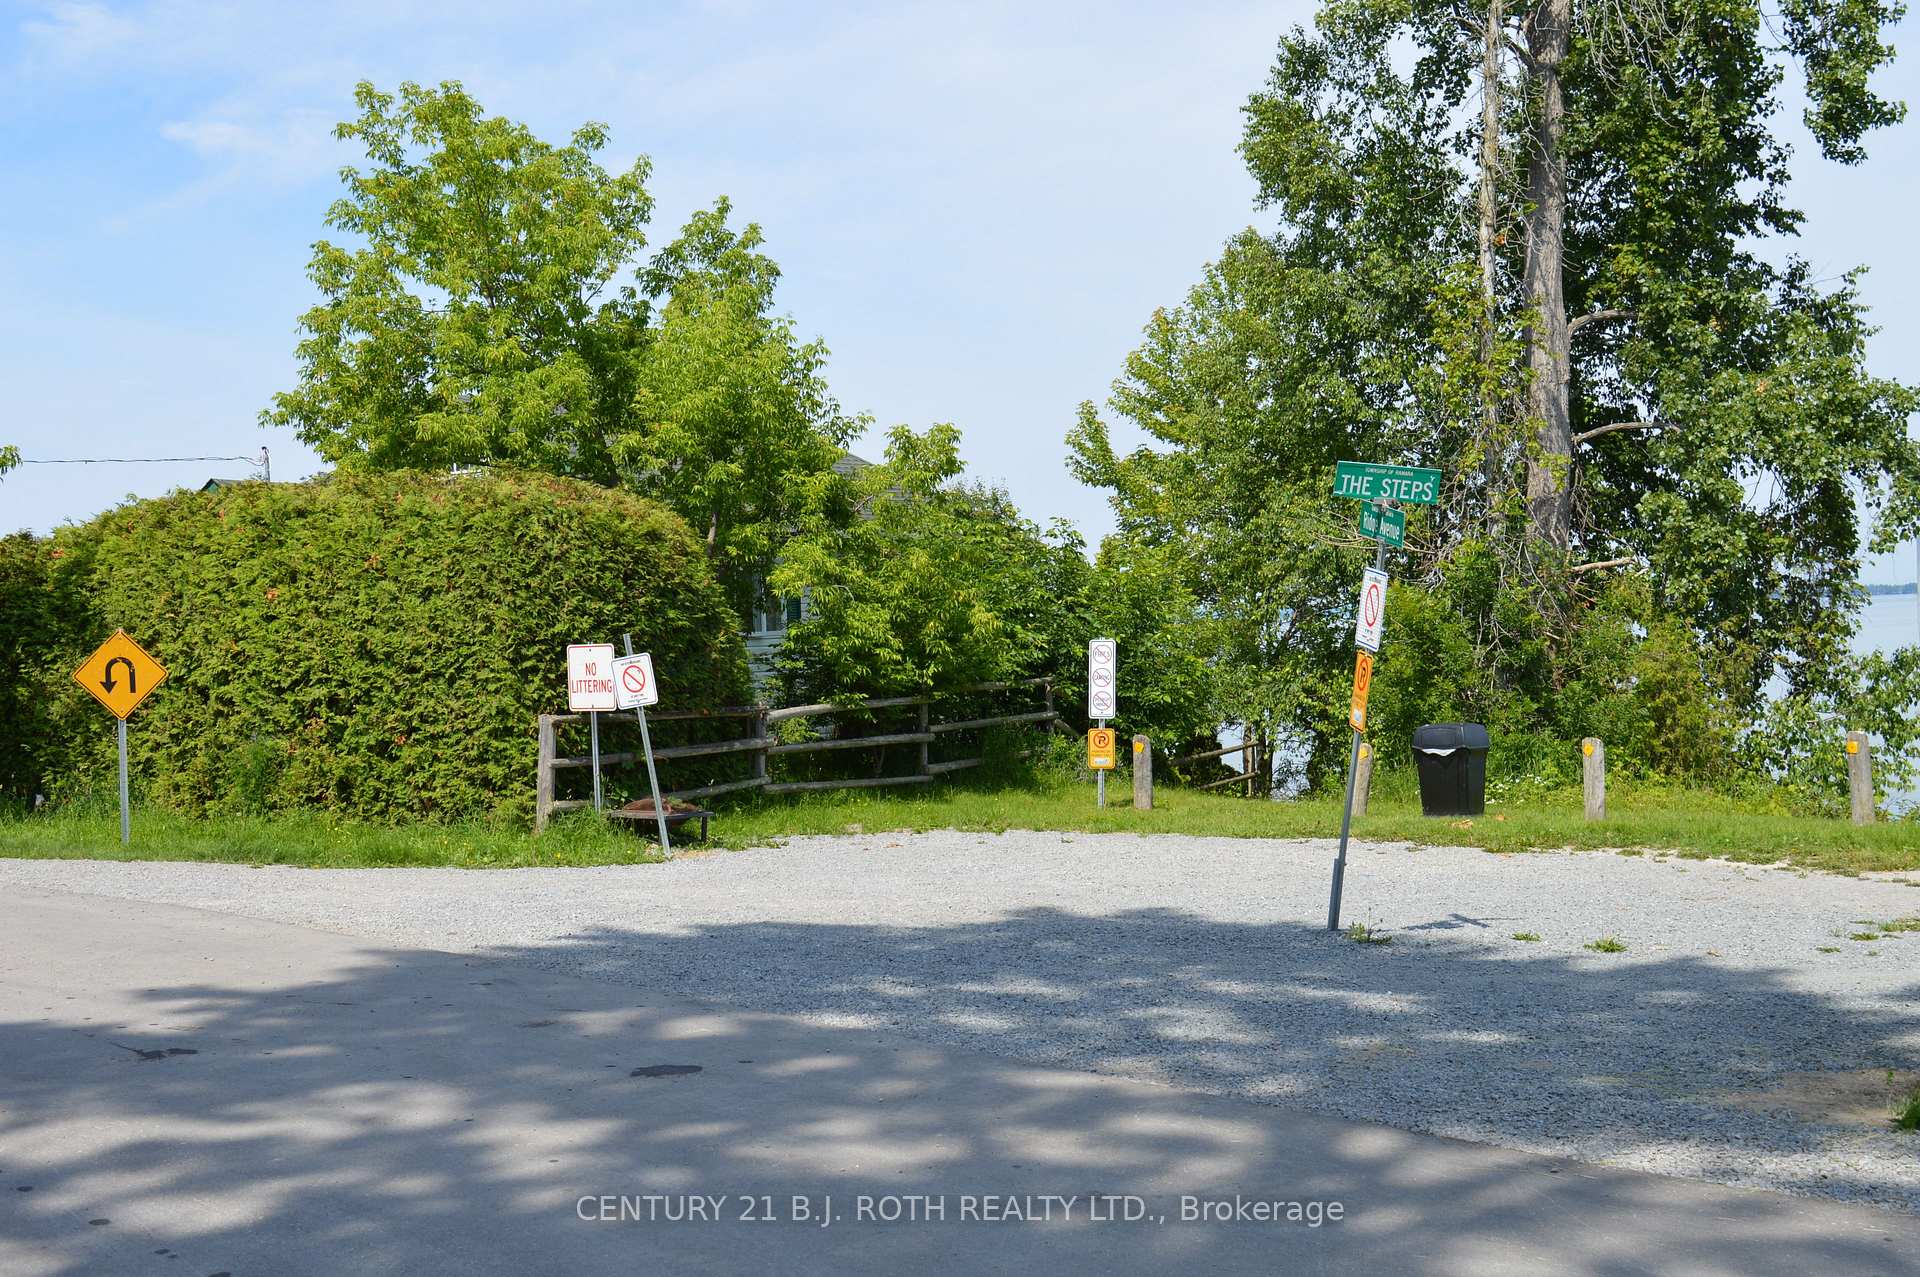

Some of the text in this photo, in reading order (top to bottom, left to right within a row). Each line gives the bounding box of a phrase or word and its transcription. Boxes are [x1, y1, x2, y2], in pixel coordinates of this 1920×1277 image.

[1341, 474, 1434, 501] THE STEPS
[1379, 517, 1401, 541] Avenue
[585, 662, 597, 676] NO
[571, 679, 613, 694] LITTERING
